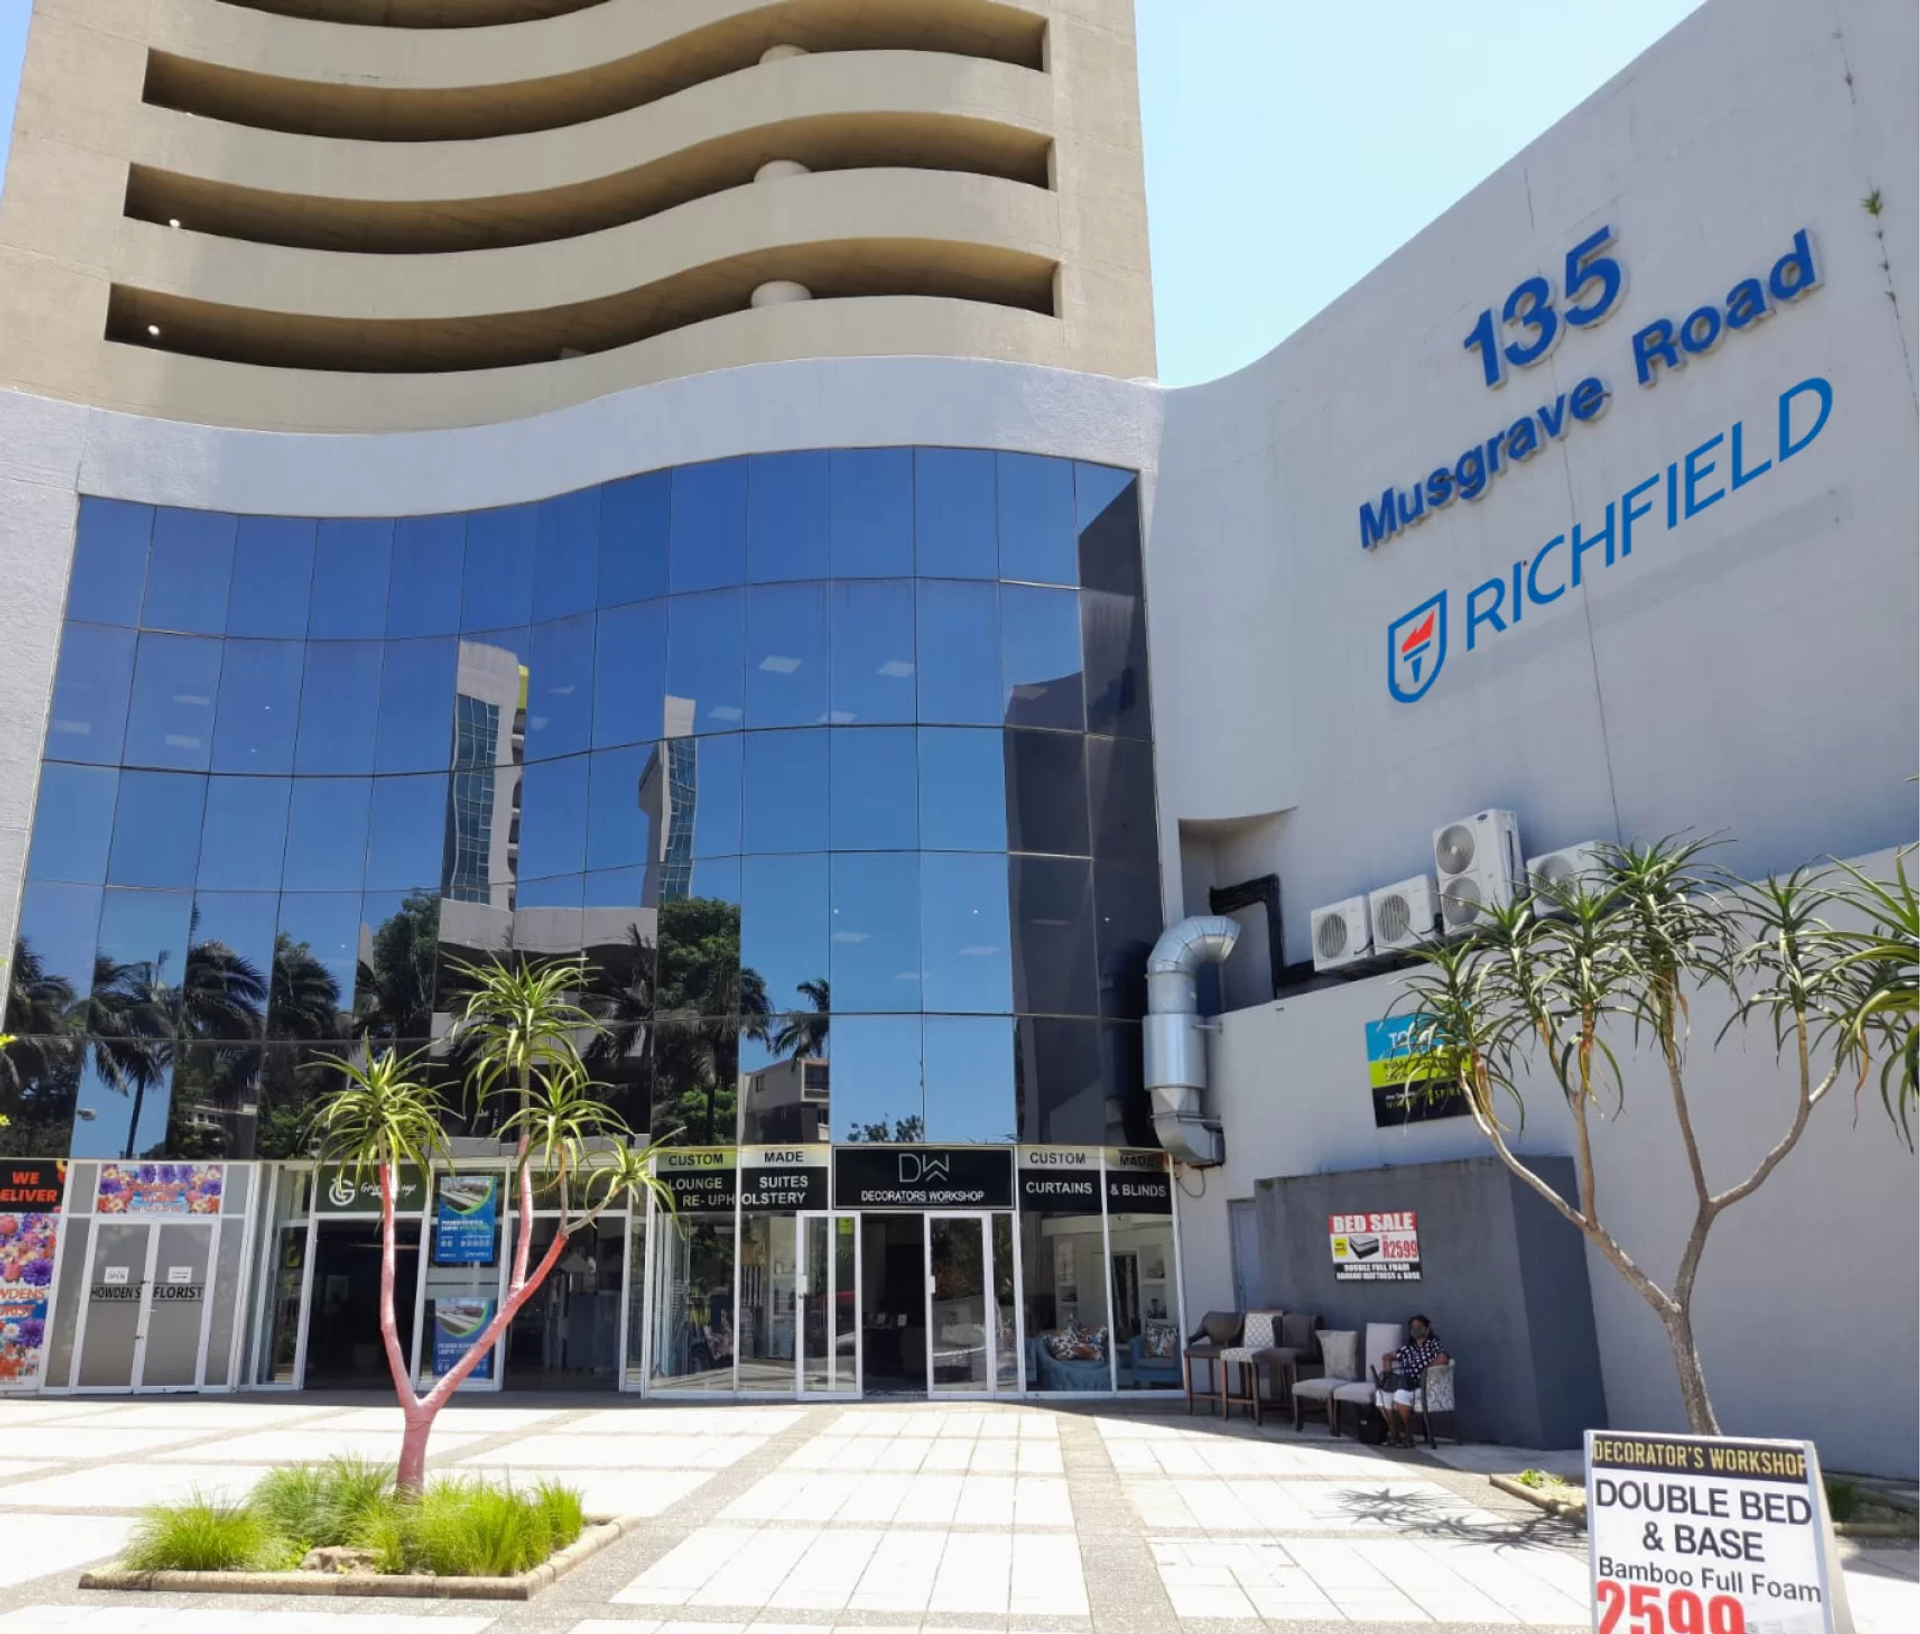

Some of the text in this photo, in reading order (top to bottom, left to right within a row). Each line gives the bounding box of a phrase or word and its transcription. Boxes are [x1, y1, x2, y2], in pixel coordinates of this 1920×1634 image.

[1463, 224, 1628, 390] 135
[1359, 228, 1824, 552] Musgrave Road
[1467, 377, 1834, 652] RICHFIELD
[669, 1150, 805, 1167] CUSTOM MADE
[1029, 1152, 1156, 1167] CUSTOM MADE
[12, 1171, 41, 1185] WE
[669, 1175, 809, 1191] LOUNGE SUITES
[0, 1188, 58, 1203] ELIVER
[861, 1190, 985, 1202] DECORATORS WORKSHOP
[1025, 1181, 1167, 1198] CURTAINS & BLINDS
[1333, 1211, 1413, 1233] BED SALE
[1382, 1240, 1418, 1259] R2599
[91, 1285, 204, 1299] HOWDEN'S FLORIST
[1593, 1439, 1705, 1469] DECORATOR'S
[1596, 1478, 1813, 1526] DOUBLE BED
[1642, 1520, 1766, 1563] & BASE
[1599, 1555, 1823, 1603] Bamboo Full Foam
